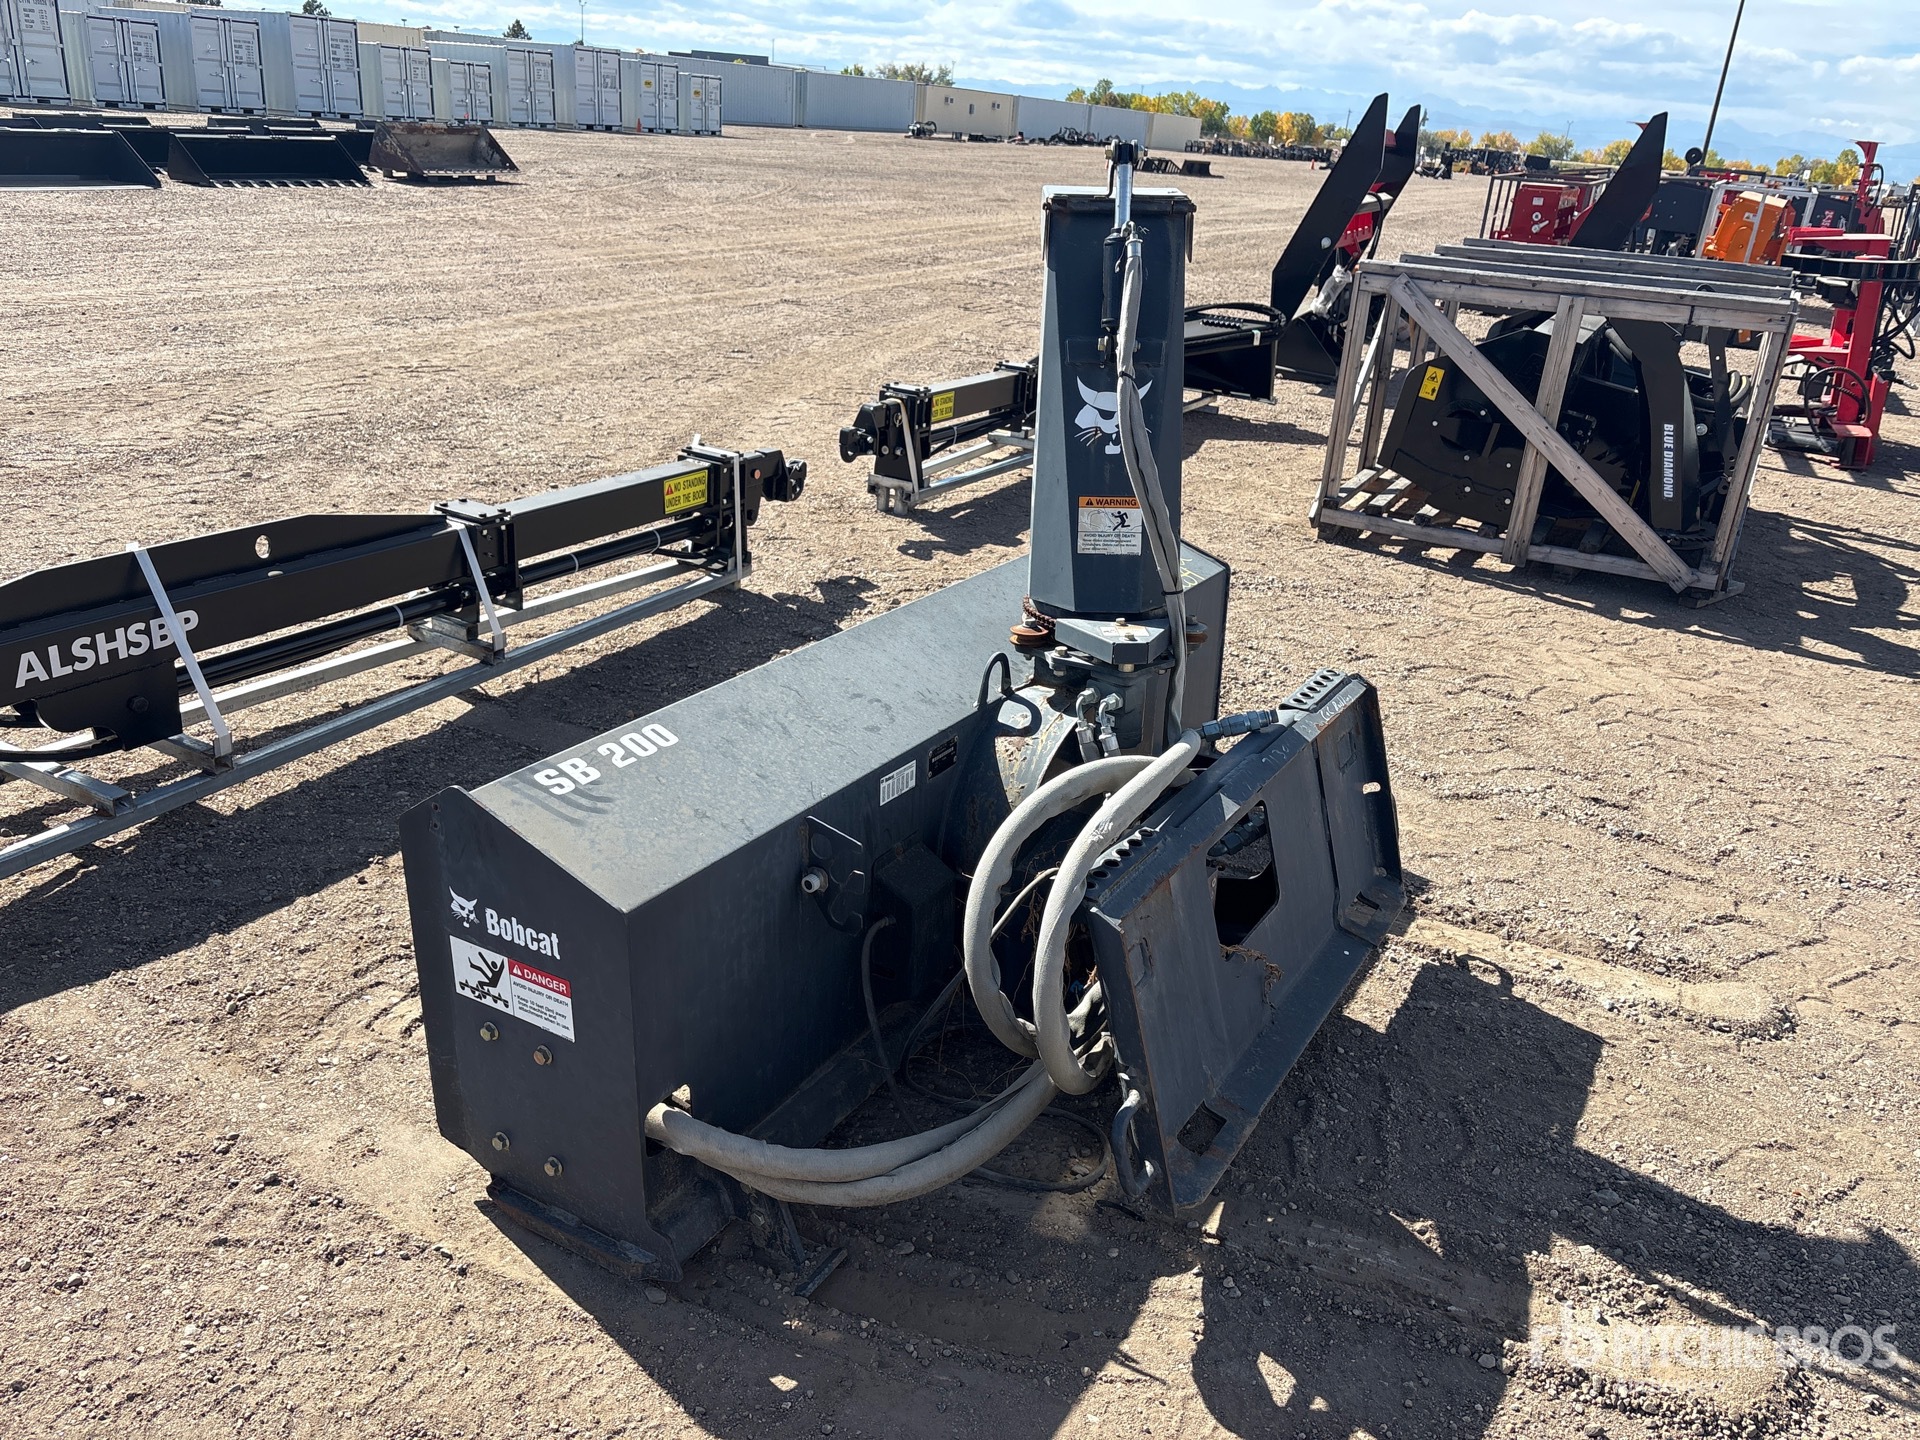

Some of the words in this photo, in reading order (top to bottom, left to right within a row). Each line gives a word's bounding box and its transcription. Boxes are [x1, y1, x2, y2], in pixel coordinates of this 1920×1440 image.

[1663, 423, 1674, 449] BLUE
[674, 482, 681, 492] NO
[682, 475, 705, 491] STANDING
[1663, 451, 1674, 498] DIAMOND
[666, 496, 681, 509] UNDER
[682, 493, 691, 504] THE
[692, 489, 706, 501] BOOM
[1095, 498, 1137, 506] WARNING
[15, 609, 199, 689] ALSHSBP
[533, 757, 601, 795] SB
[597, 723, 679, 768] 200
[485, 907, 561, 960] Bobcat
[512, 980, 527, 990] AVOID
[528, 986, 544, 996] INJURY
[545, 993, 553, 1001] OR
[553, 997, 569, 1007] DEATH
[523, 968, 567, 994] DANGER
